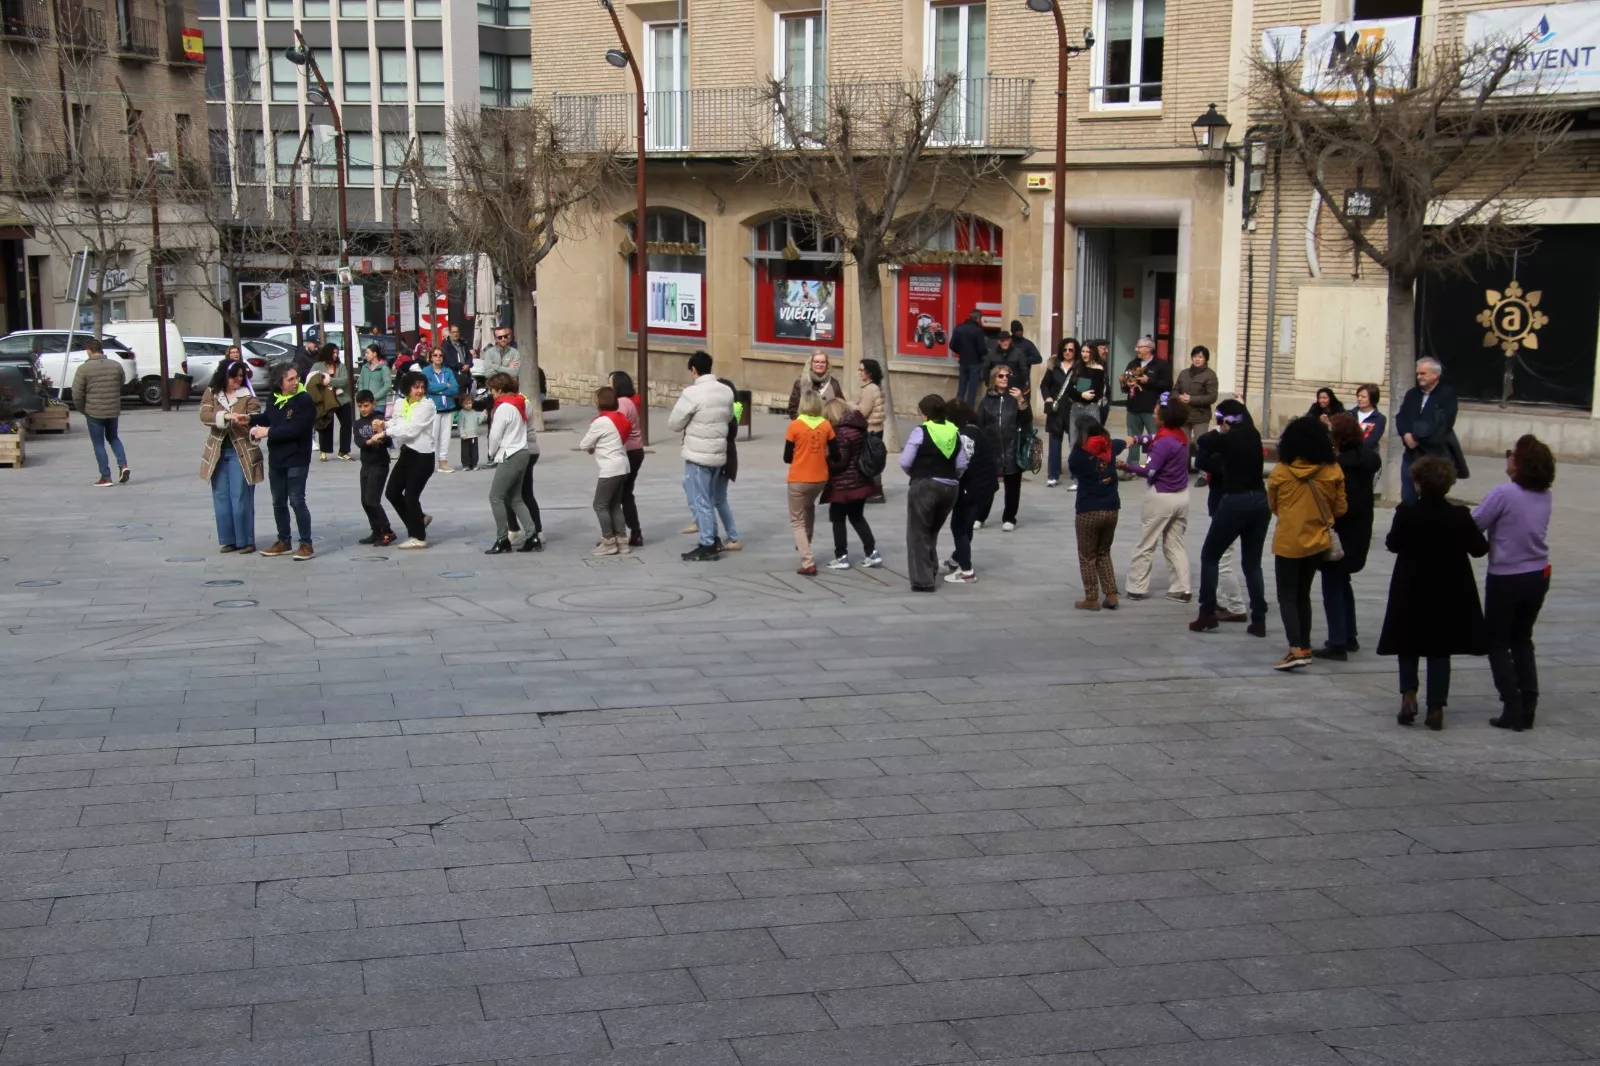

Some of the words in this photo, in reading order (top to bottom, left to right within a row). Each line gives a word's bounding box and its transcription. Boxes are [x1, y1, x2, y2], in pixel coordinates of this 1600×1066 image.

[1489, 46, 1597, 72] SRVENT
[780, 307, 828, 322] VUELTAS
[1502, 306, 1521, 331] a
[309, 329, 316, 337] P
